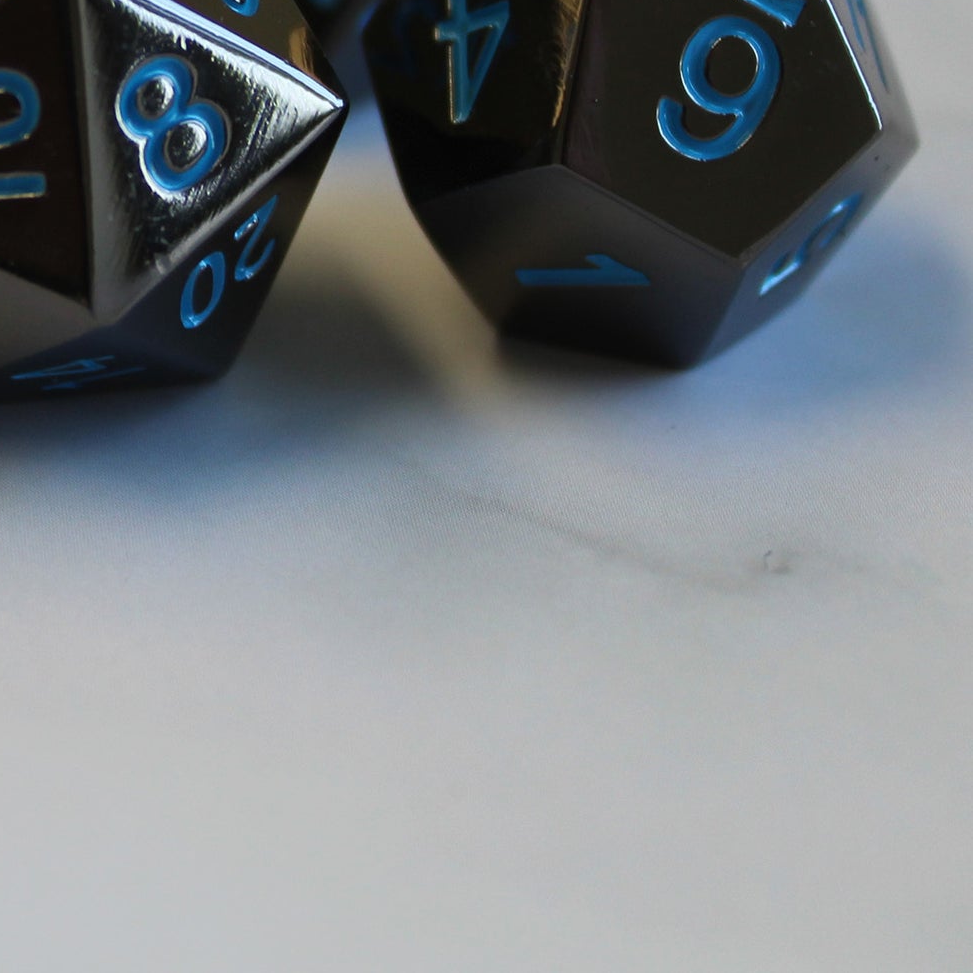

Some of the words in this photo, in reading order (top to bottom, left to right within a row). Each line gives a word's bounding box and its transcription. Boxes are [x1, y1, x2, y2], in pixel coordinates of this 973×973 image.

[115, 54, 231, 196] 8
[179, 195, 278, 329] 20
[515, 253, 650, 285] 1
